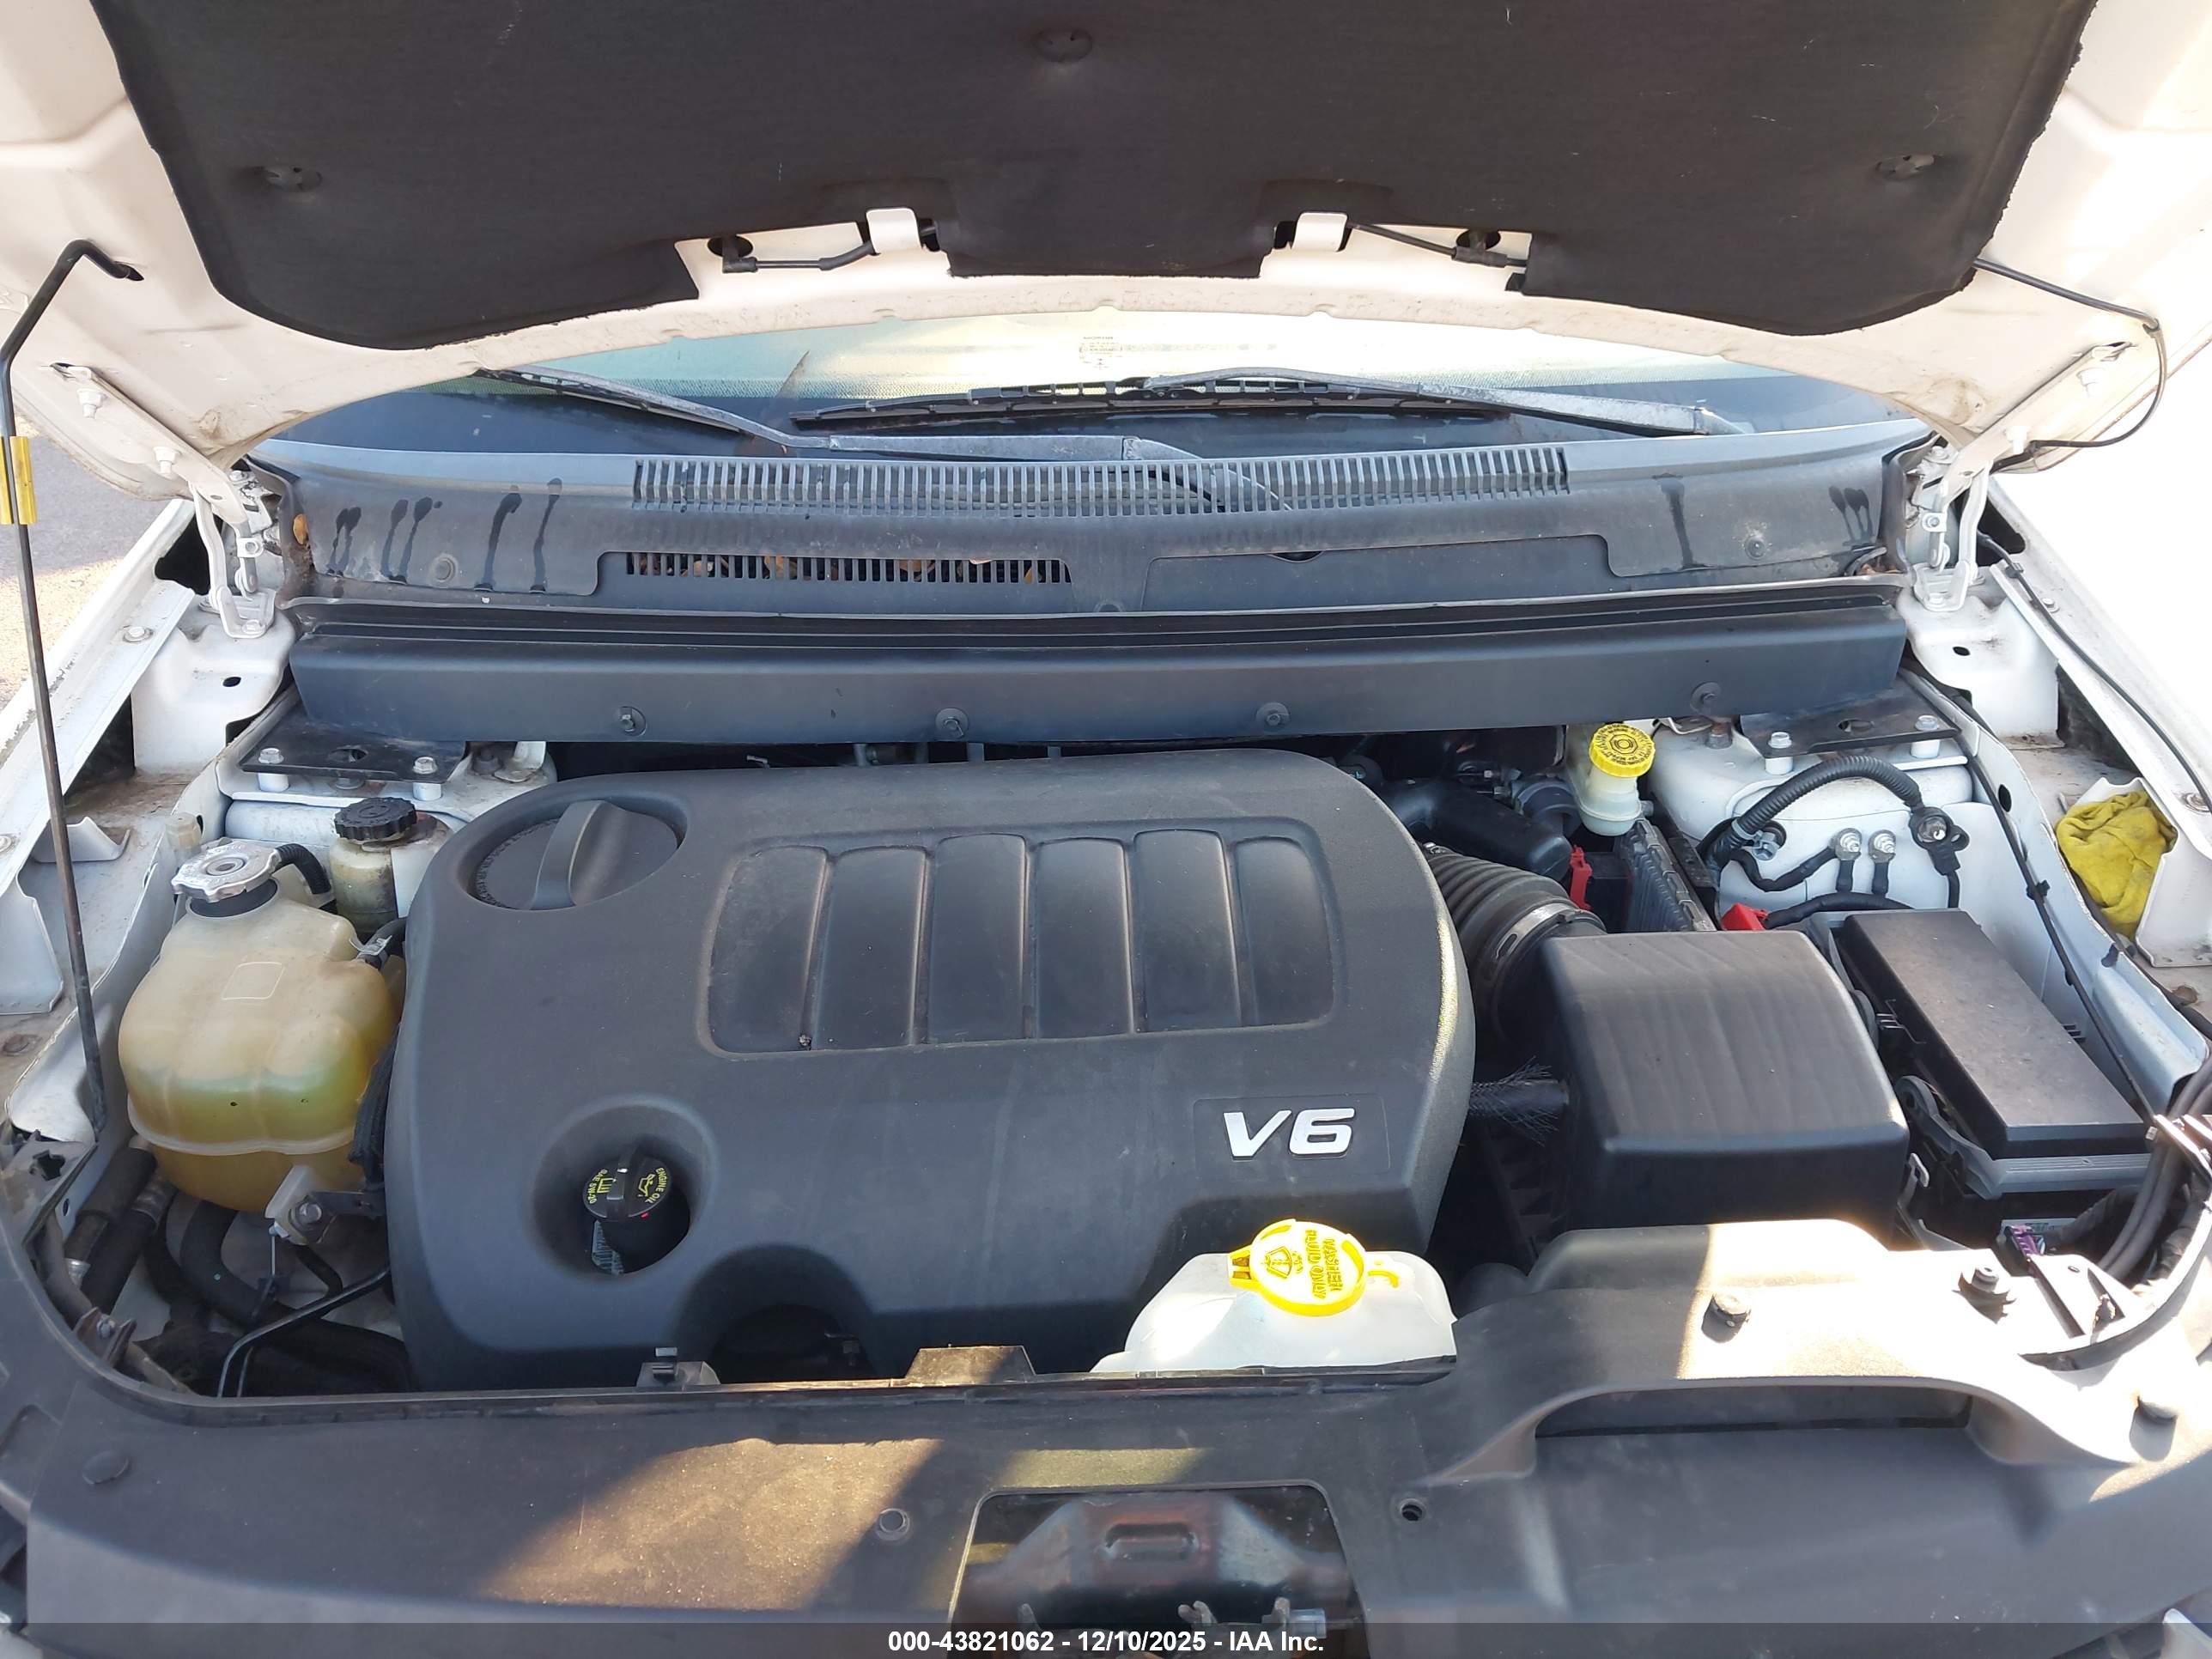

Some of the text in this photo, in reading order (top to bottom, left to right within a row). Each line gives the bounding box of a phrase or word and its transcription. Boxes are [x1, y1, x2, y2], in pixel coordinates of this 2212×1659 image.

[1223, 1108, 1356, 1158] V6
[587, 1169, 608, 1205] SAE 5W-20
[644, 1167, 667, 1204] ENGINE OIL
[1305, 1229, 1327, 1299] FLUID ONLY
[1322, 1238, 1344, 1291] WASHER
